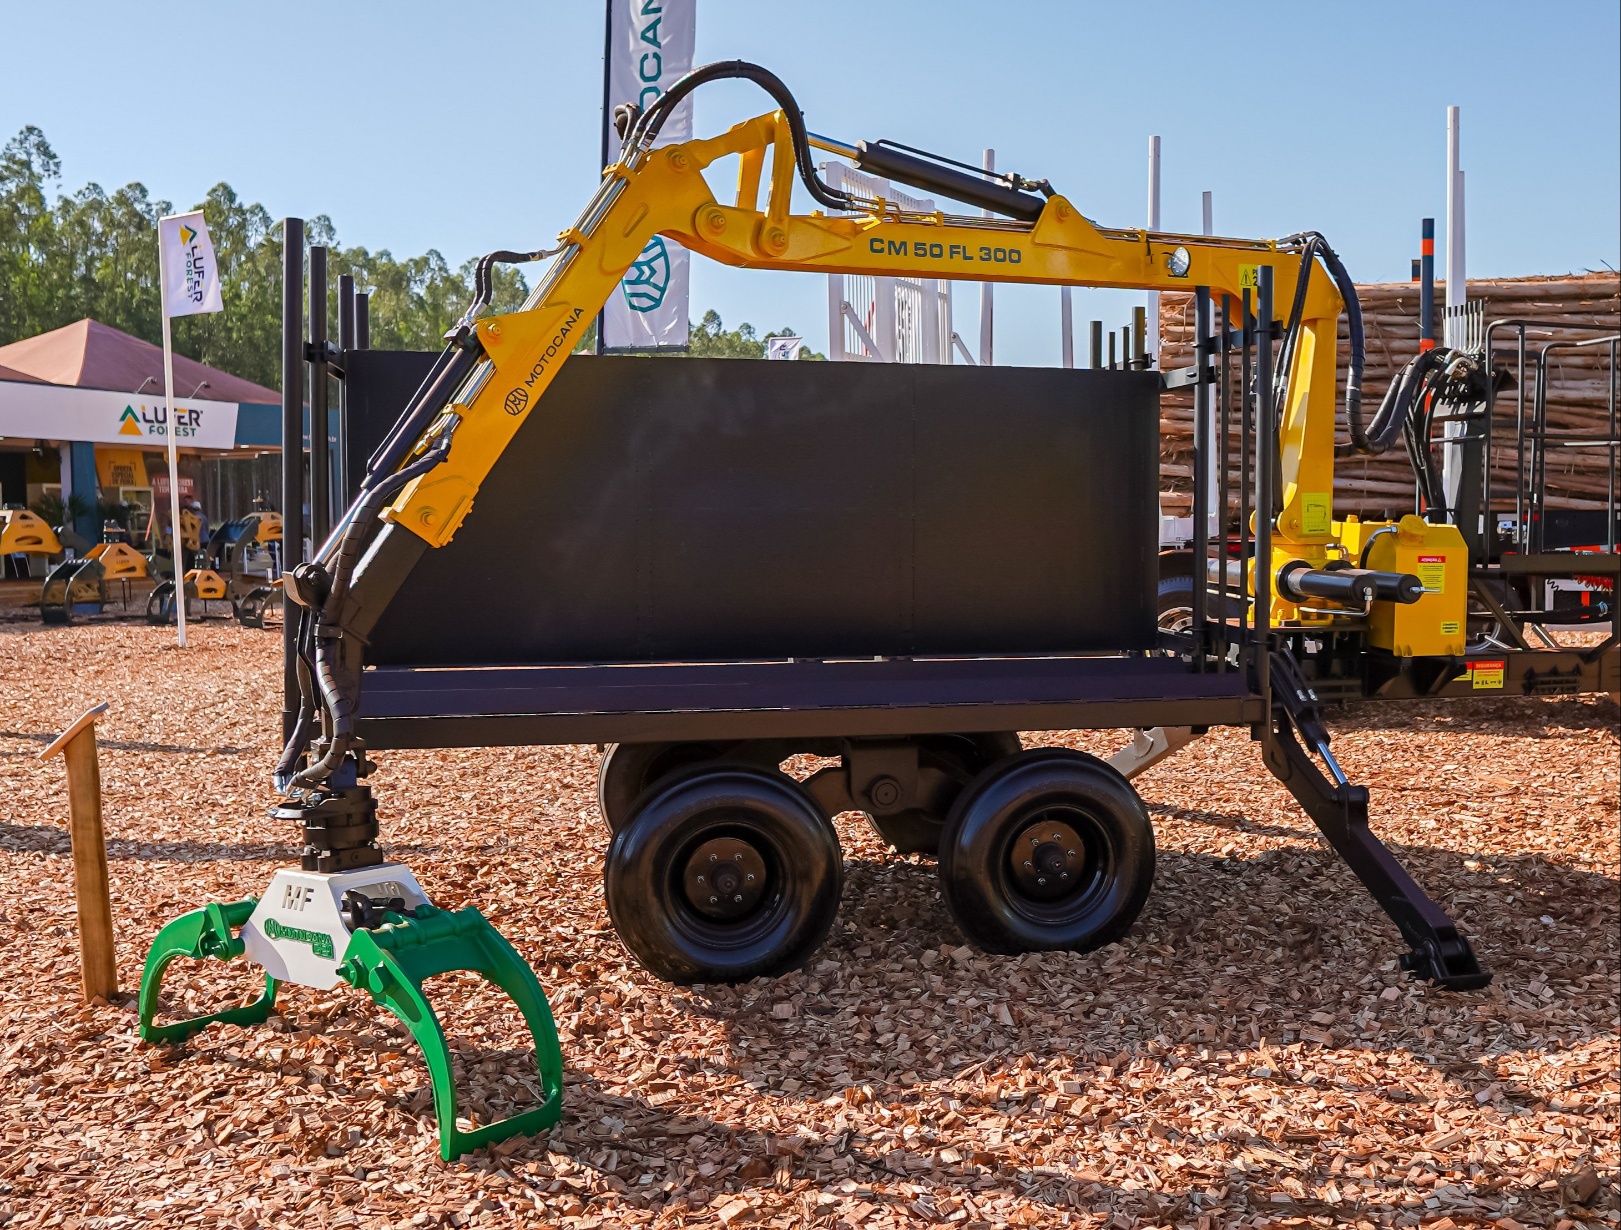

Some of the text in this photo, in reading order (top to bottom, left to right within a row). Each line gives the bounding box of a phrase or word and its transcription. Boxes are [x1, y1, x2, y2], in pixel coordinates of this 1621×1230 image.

[191, 244, 205, 304] LUFER
[869, 237, 1022, 264] CM 50 FL 300
[185, 252, 193, 299] FOREST
[524, 307, 585, 388] MOTOCANA
[282, 884, 315, 911] MF
